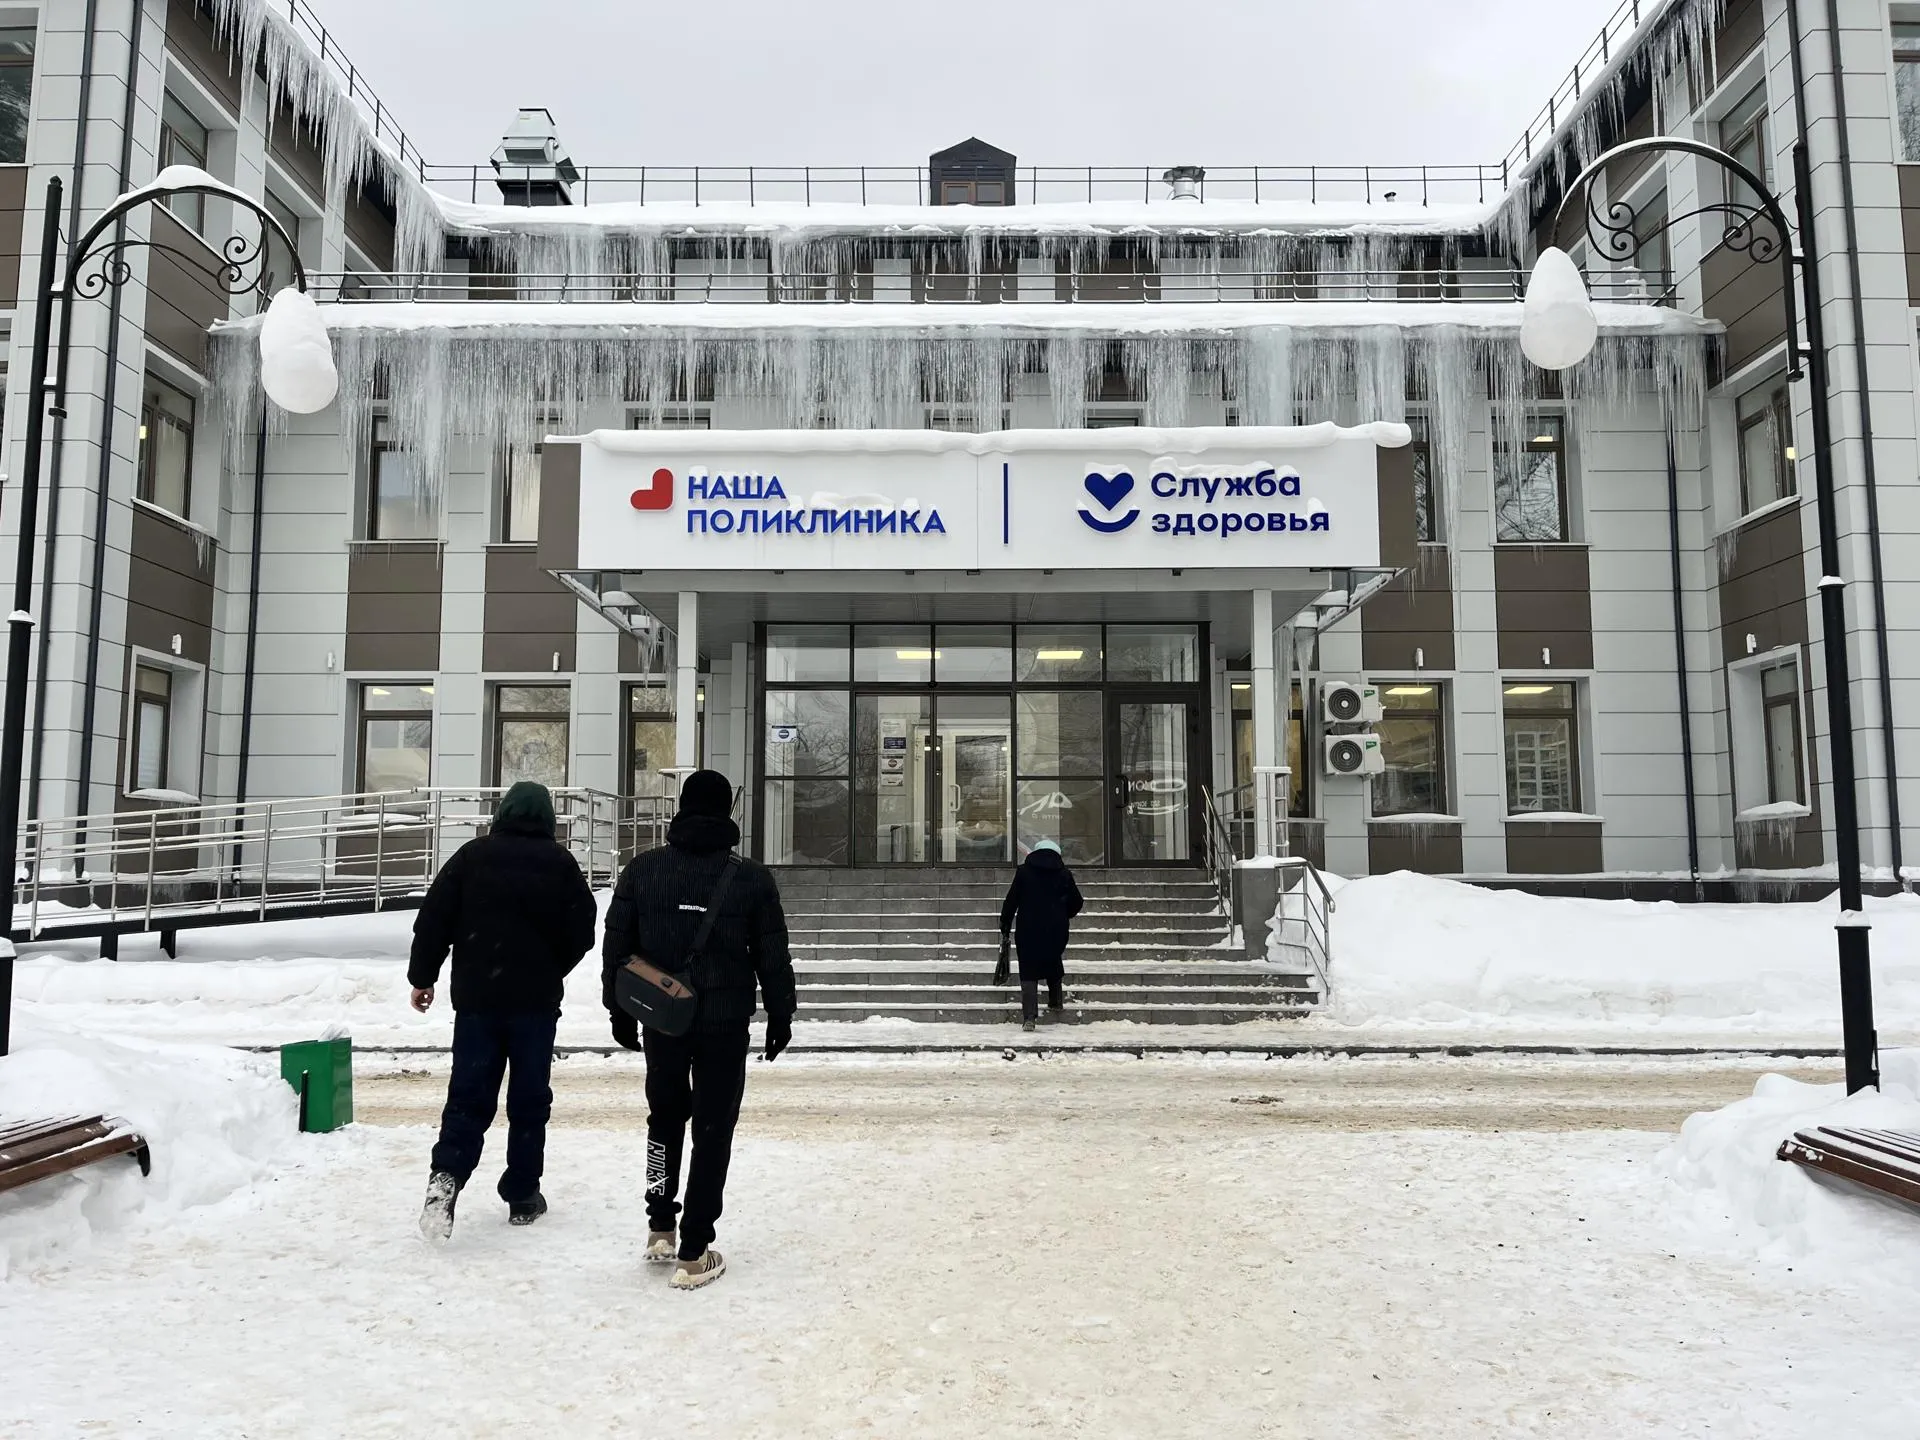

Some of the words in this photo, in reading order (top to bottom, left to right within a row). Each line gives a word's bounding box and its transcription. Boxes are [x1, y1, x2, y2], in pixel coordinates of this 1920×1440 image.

[687, 475, 787, 500] НАША
[1151, 470, 1301, 504] Служба
[687, 509, 946, 534] ПОЛИКЛИНИКА
[1151, 512, 1330, 537] здоровья
[647, 1139, 666, 1196] NIKE
